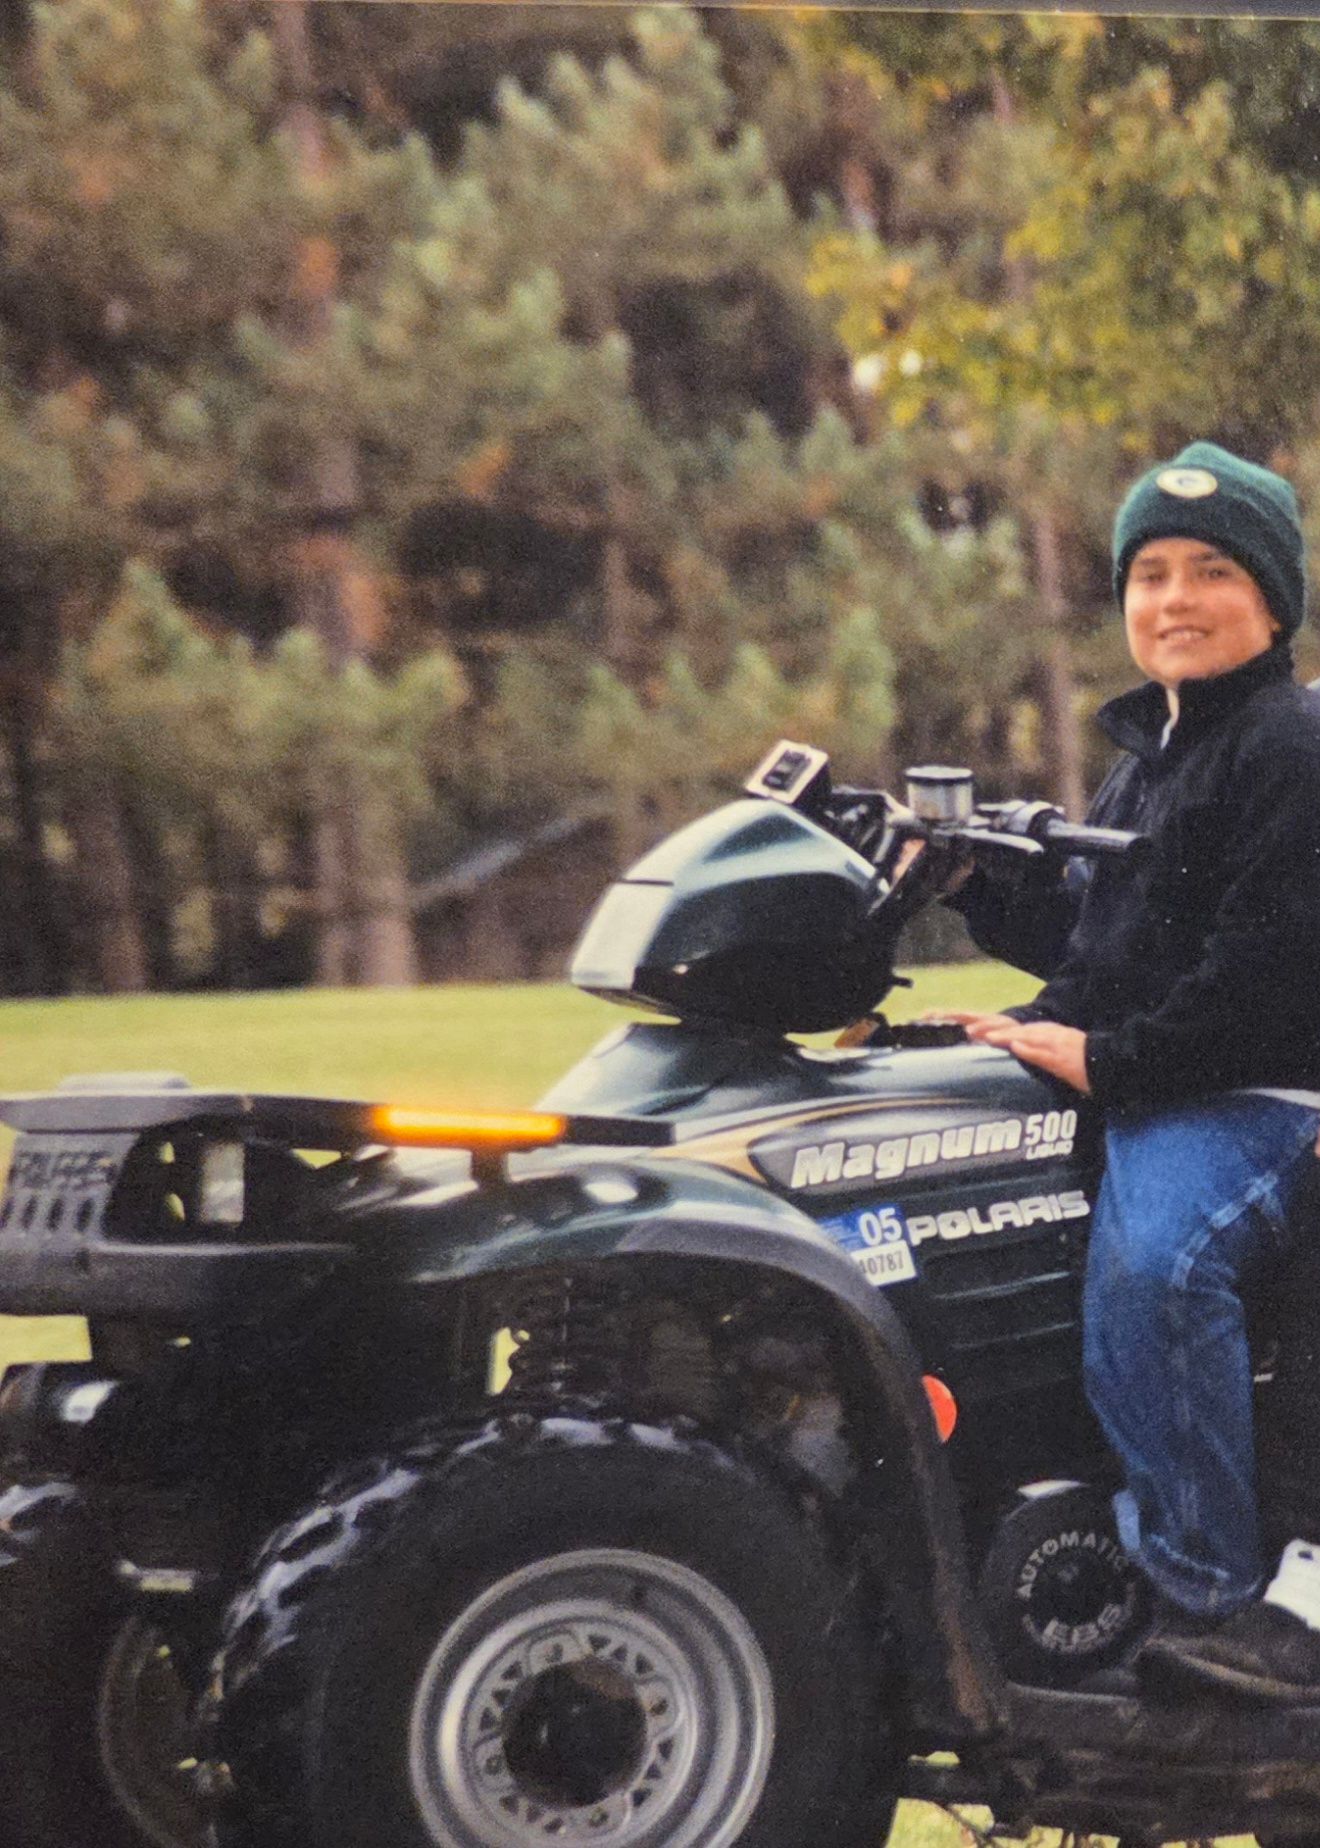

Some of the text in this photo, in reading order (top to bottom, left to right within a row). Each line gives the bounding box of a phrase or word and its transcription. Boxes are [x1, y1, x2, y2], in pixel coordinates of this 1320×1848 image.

[791, 1109, 1078, 1188] Magnum 500
[858, 1207, 902, 1246] 05
[905, 1190, 1090, 1245] POLARIS
